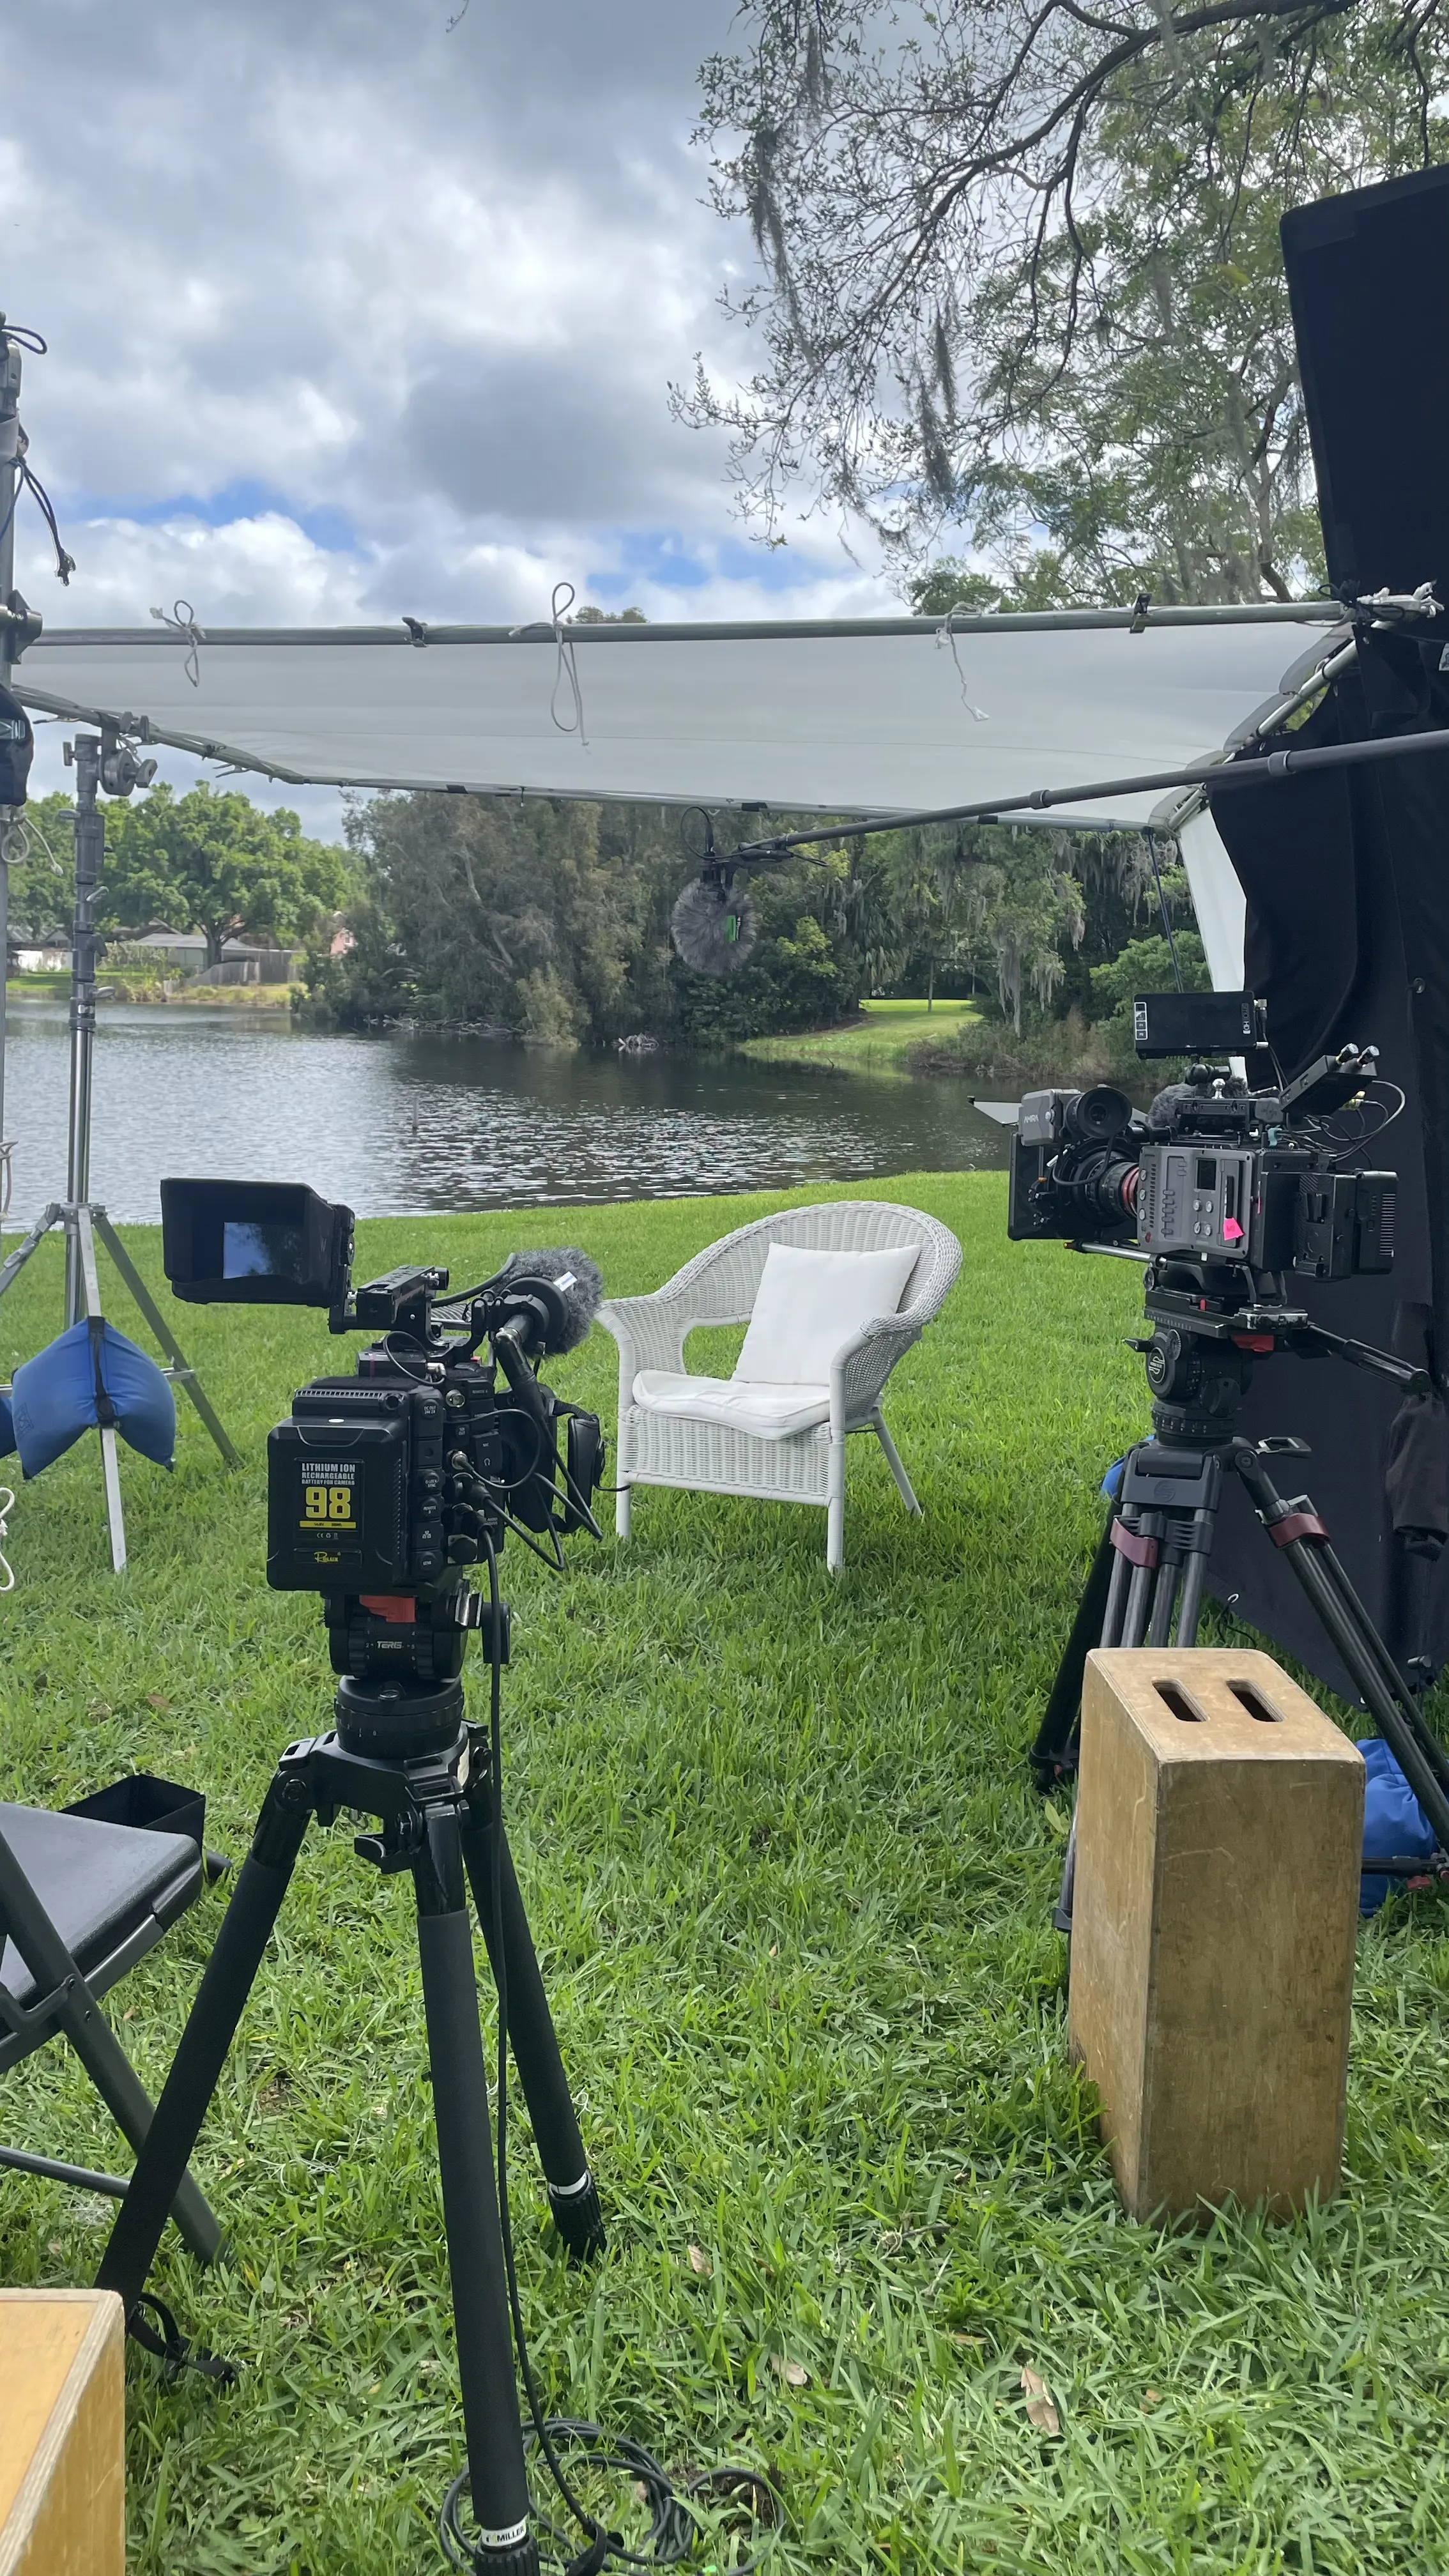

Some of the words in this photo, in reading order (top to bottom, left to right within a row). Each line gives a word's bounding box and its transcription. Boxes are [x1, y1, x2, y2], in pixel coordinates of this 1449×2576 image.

[302, 1463, 338, 1472] LITHIUM
[340, 1464, 355, 1472] ION
[305, 1487, 351, 1519] 98
[497, 2526, 524, 2542] MILLER
